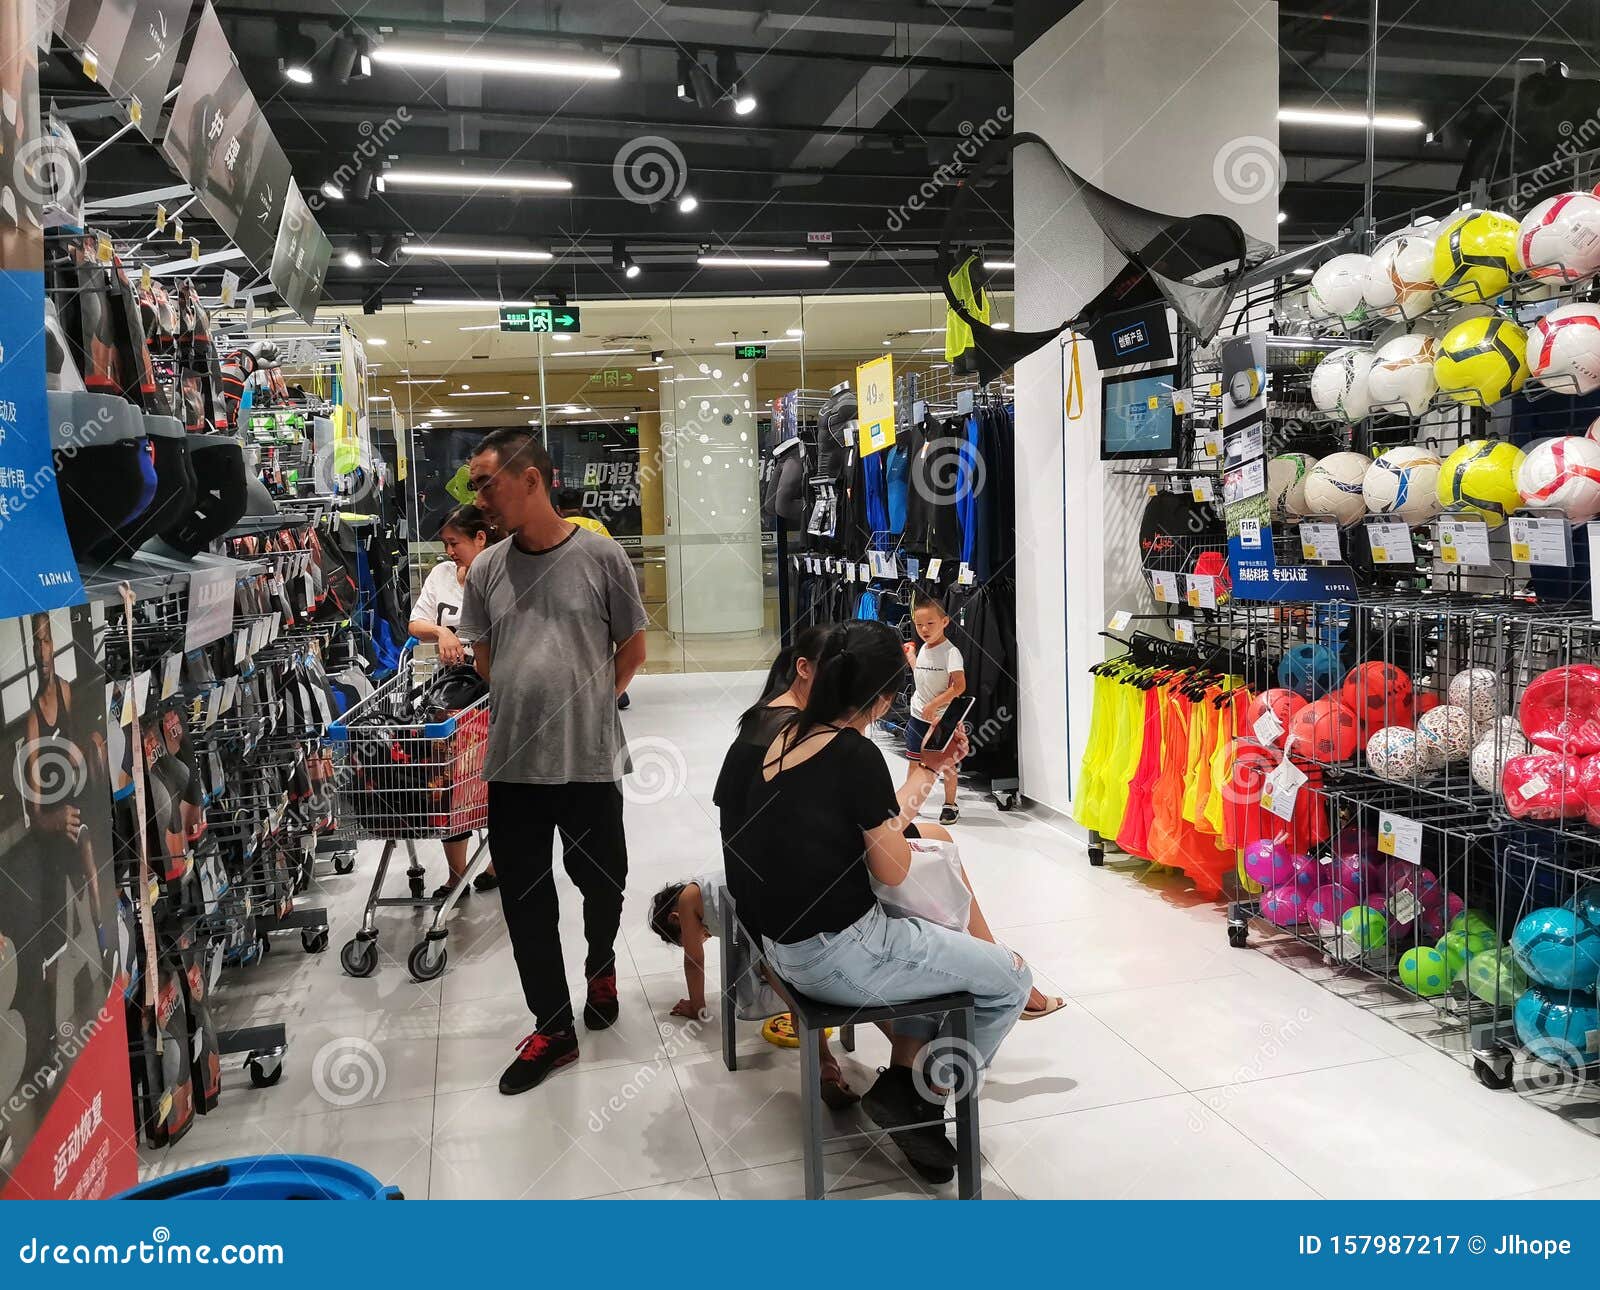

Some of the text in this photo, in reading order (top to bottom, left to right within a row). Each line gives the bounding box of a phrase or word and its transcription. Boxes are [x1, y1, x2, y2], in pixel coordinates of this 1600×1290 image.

[1118, 328, 1144, 349] 创新产品
[1241, 521, 1258, 531] FIFA
[38, 571, 74, 587] TARMAK
[1239, 568, 1309, 582] 热粘科技 专业认证
[1325, 584, 1351, 592] KIPSTA
[54, 1090, 103, 1191] 运动恢复
